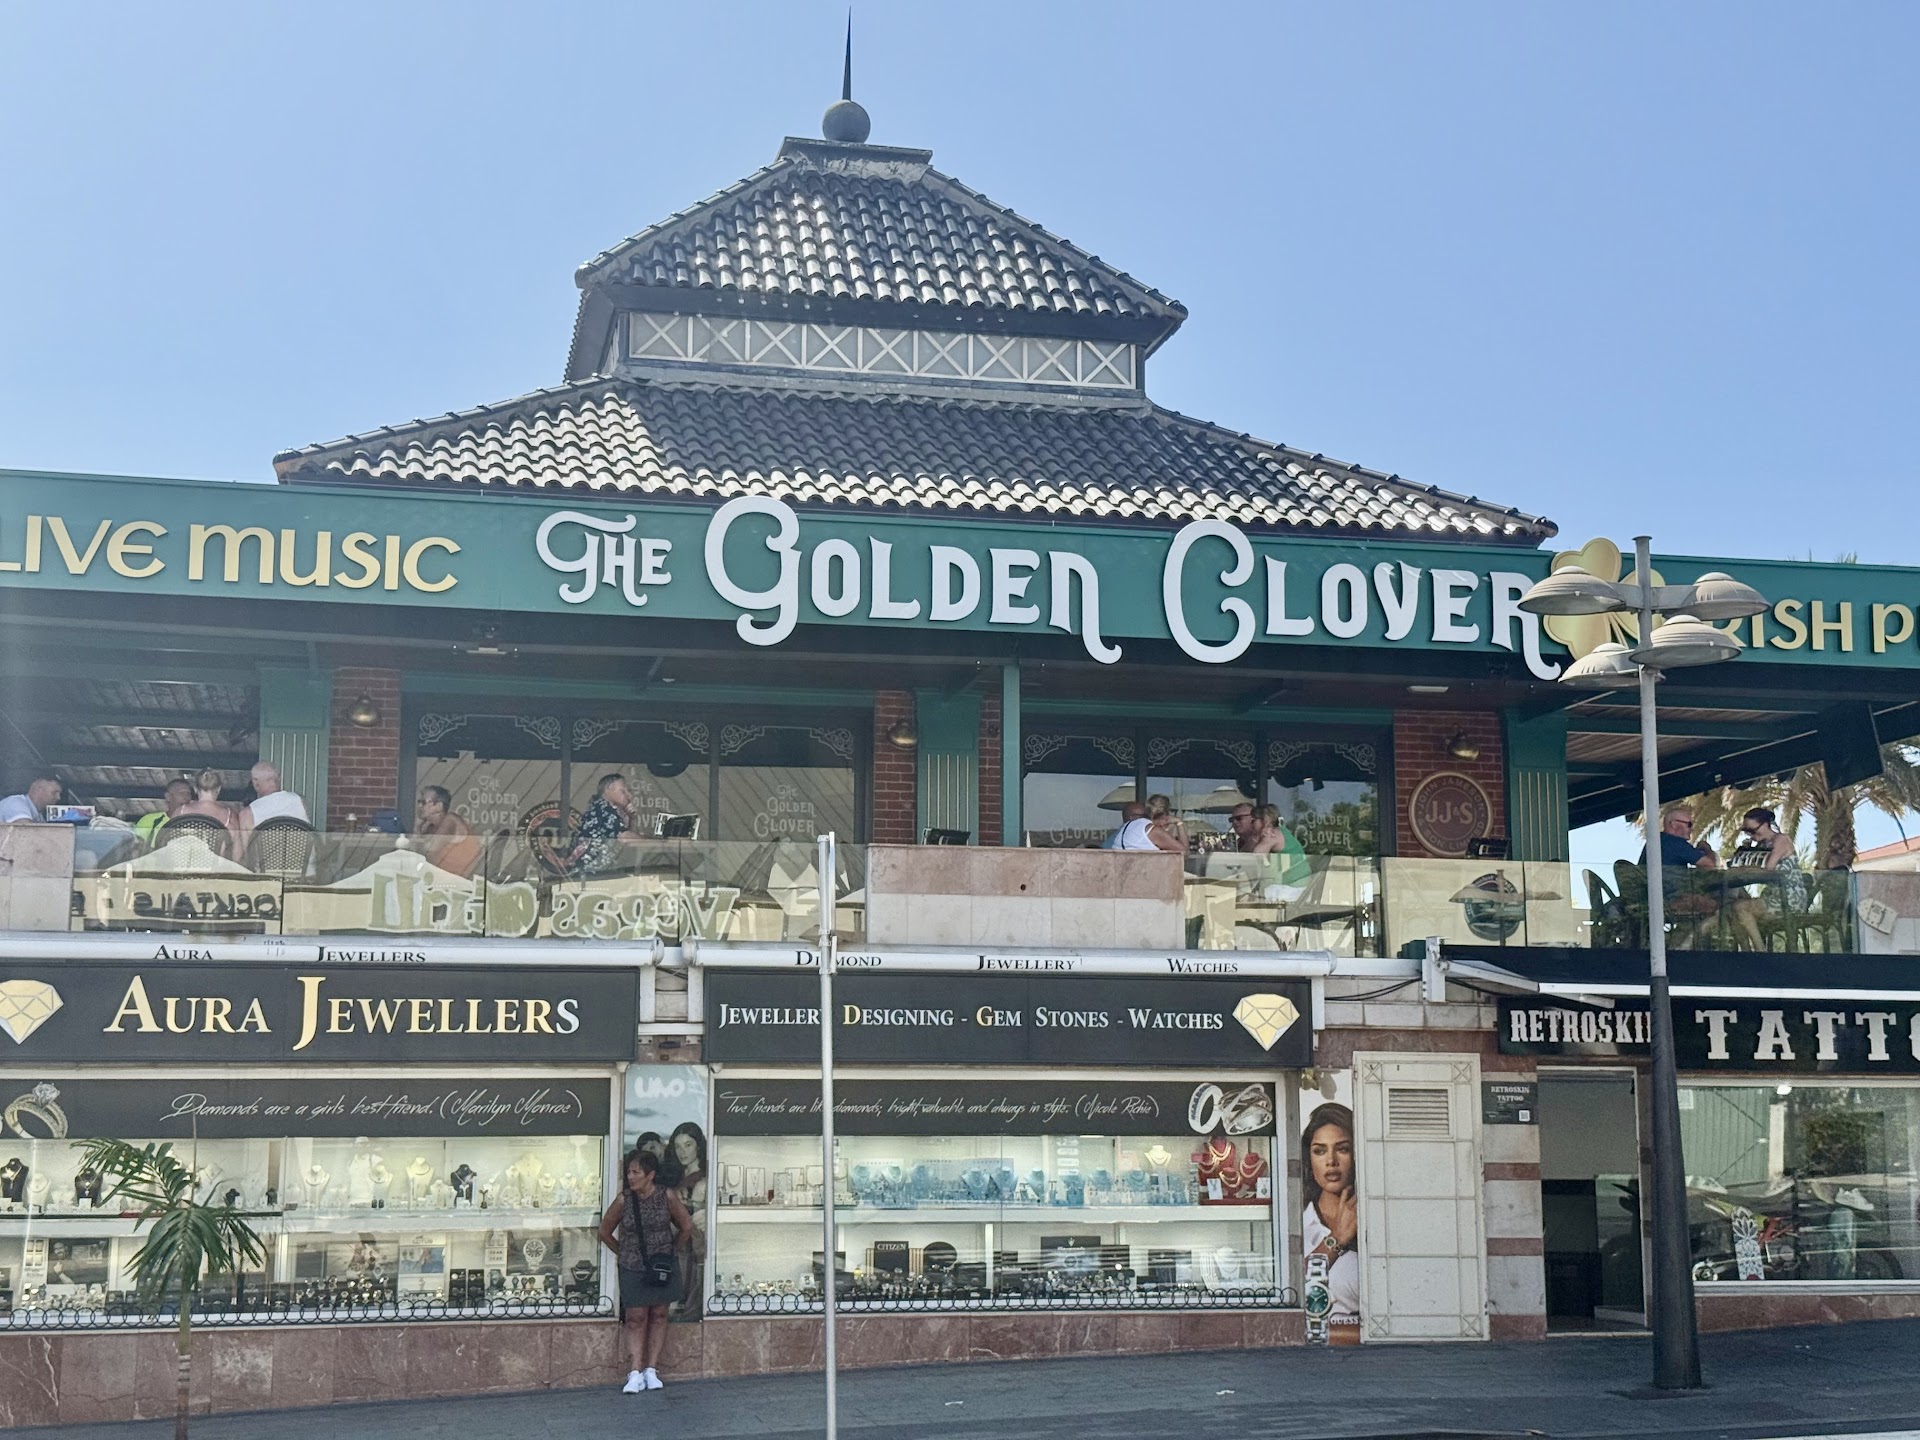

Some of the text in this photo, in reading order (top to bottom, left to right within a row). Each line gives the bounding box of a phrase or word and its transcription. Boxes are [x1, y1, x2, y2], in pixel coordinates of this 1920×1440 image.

[535, 495, 1563, 681] THE GOLDEN CLOVER
[633, 797, 671, 813] OLDEN
[754, 812, 817, 839] CLOVER
[153, 944, 426, 963] AURA JEWELLERS
[795, 950, 1238, 973] DIMOND JEWELLERY WATCHES
[103, 974, 581, 1052] AURA JEWELLERS
[718, 1003, 822, 1028] JEWELLER
[843, 1004, 954, 1026] DESIGNING
[976, 1005, 1022, 1027] GEM
[1035, 1006, 1109, 1028] STONES
[1127, 1008, 1223, 1030] WATCHES
[1510, 1010, 1651, 1043] RETROSKI
[1695, 1010, 1920, 1061] TATT
[1491, 1086, 1530, 1094] RETROSKIN
[160, 1093, 263, 1121] Diamonds
[265, 1104, 290, 1115] are
[295, 1104, 308, 1115] a
[306, 1095, 345, 1121] girls
[351, 1096, 398, 1115] best
[720, 1091, 761, 1113] True
[749, 1097, 785, 1117] friends
[788, 1104, 806, 1113] are
[809, 1097, 823, 1113] lik
[967, 1098, 994, 1113] and
[991, 1097, 1026, 1123] always
[1029, 1101, 1040, 1113] in
[1121, 1094, 1159, 1120] Richie)
[877, 1243, 907, 1251] CITIZEN
[1330, 1316, 1359, 1325] GUESS
